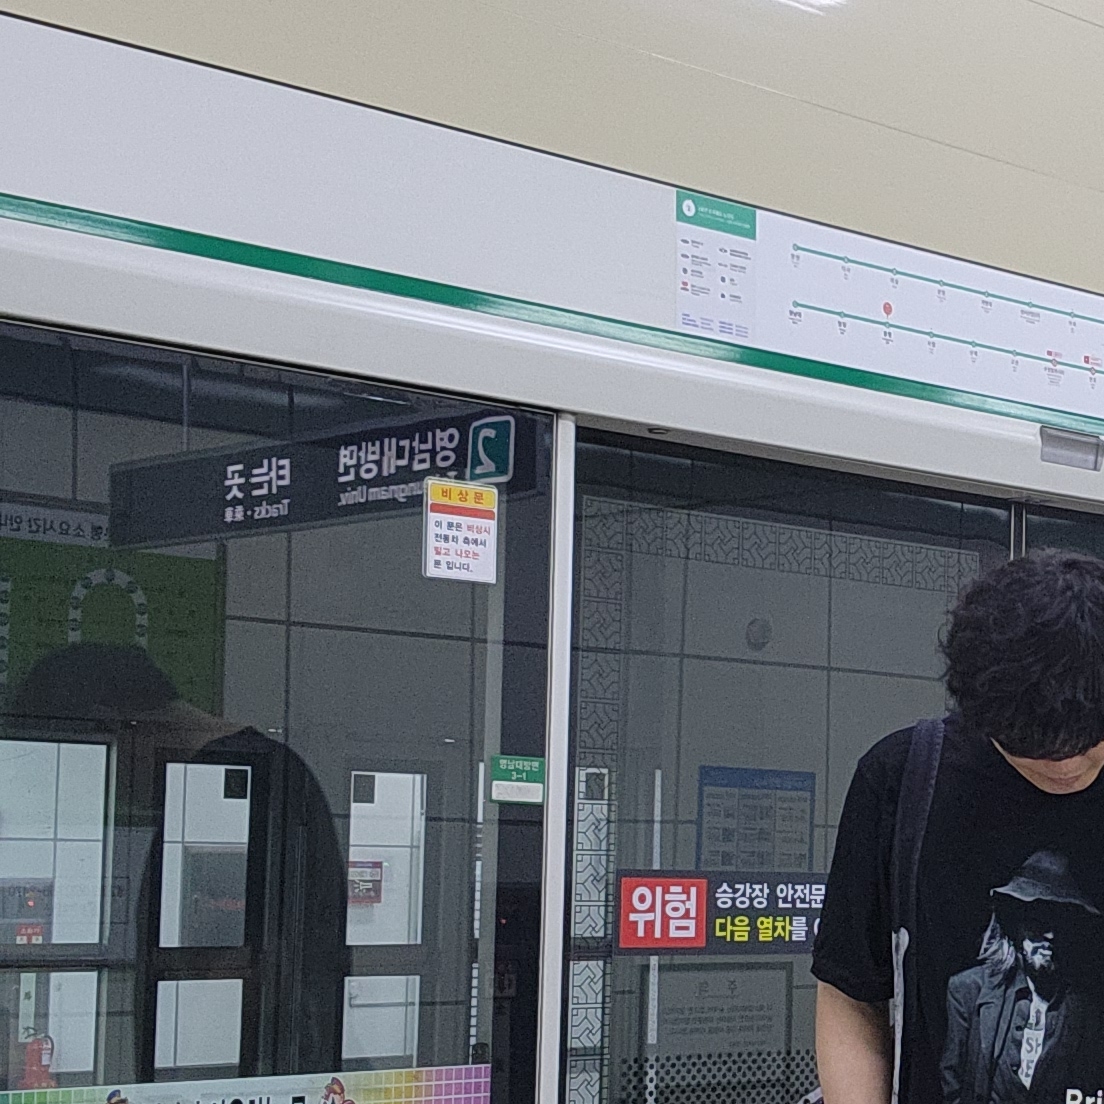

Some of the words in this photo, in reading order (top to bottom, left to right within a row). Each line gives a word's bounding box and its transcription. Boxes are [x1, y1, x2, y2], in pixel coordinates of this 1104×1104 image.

[441, 487, 484, 505] 비상문
[434, 520, 443, 530] 이
[511, 771, 527, 781] 3-1
[715, 882, 770, 909] 승강장
[628, 885, 697, 939] 위험
[715, 915, 751, 942] 다음
[756, 915, 808, 942] 열차를
